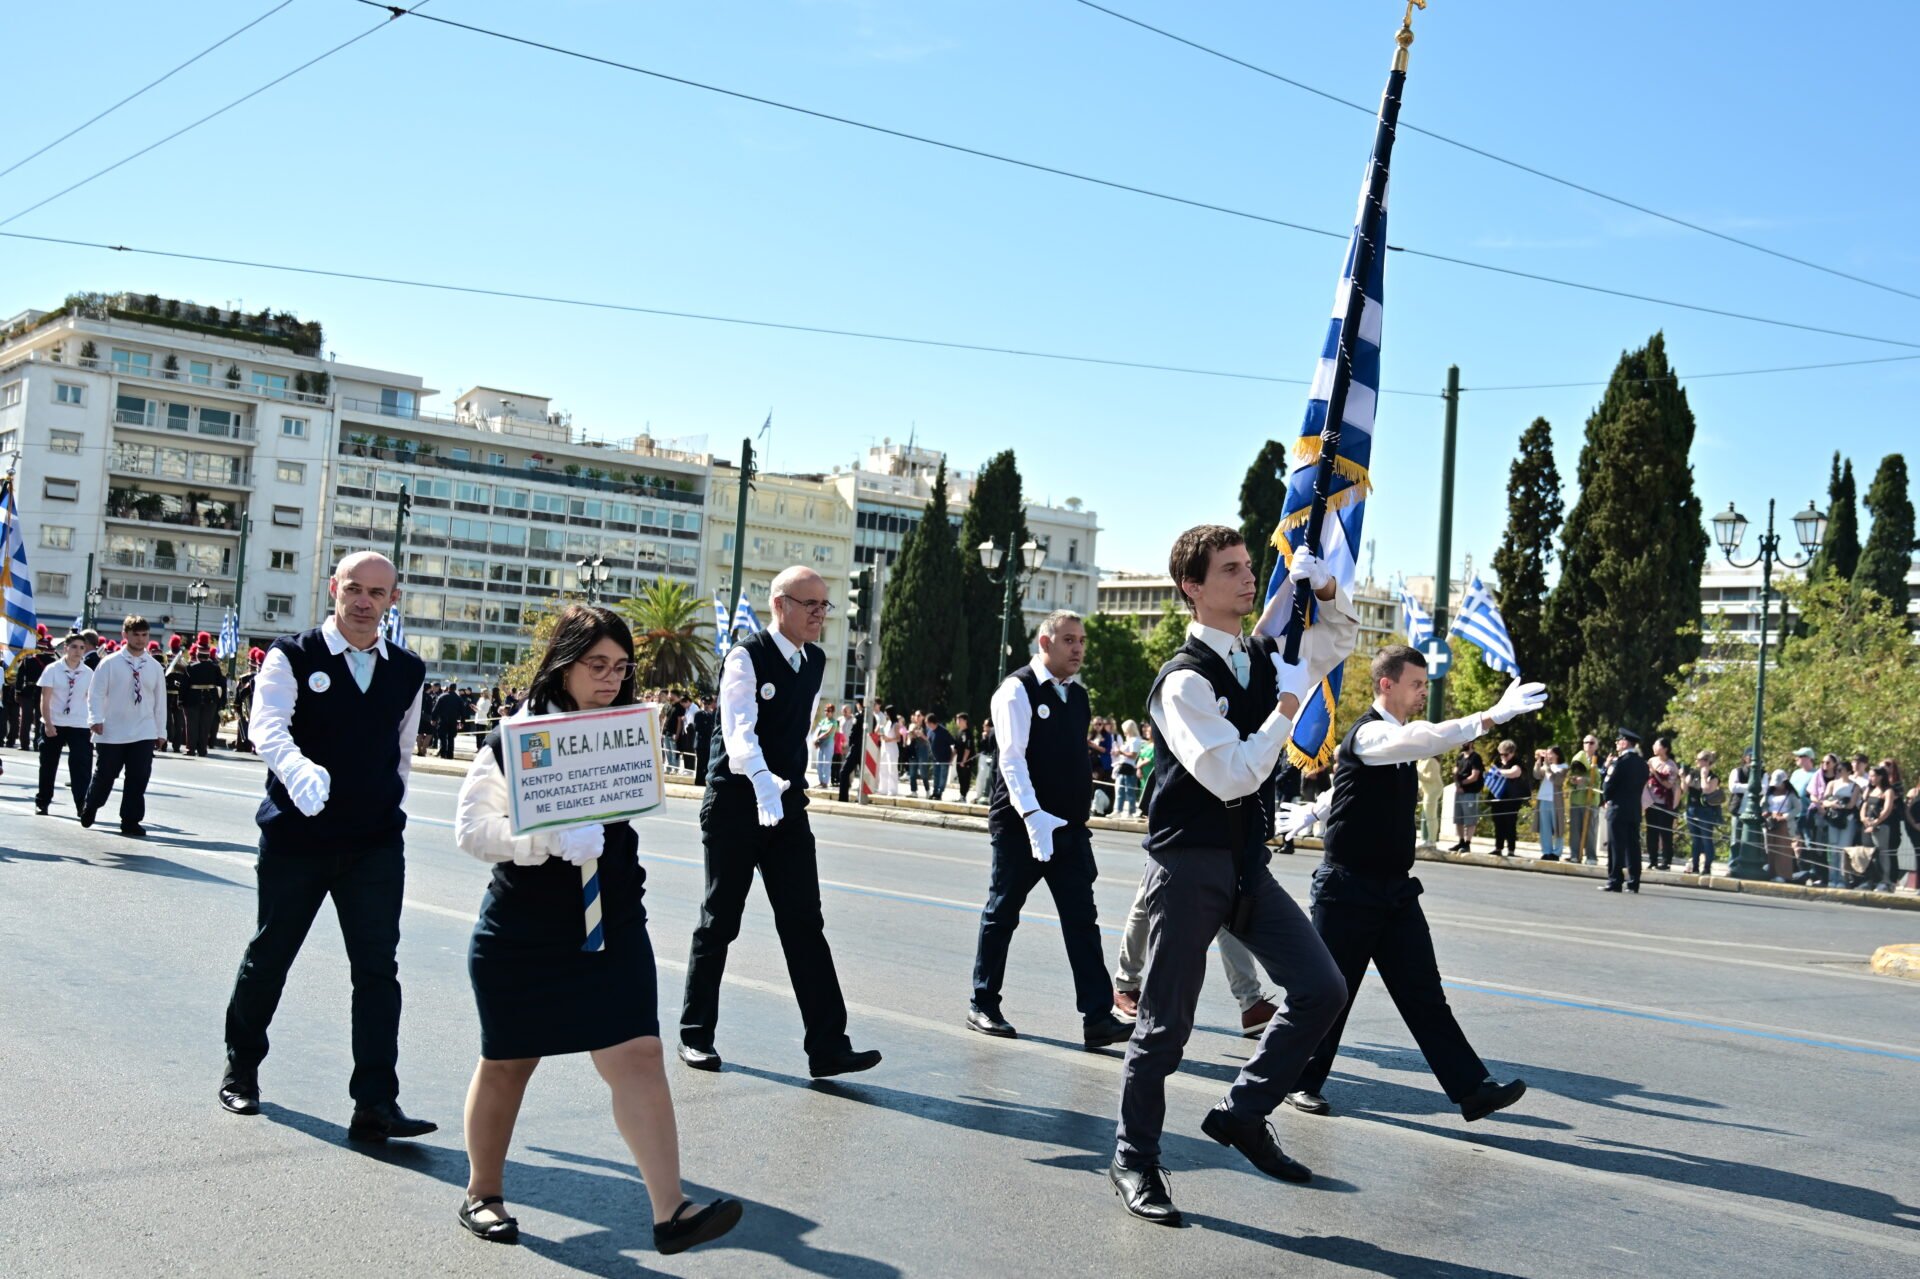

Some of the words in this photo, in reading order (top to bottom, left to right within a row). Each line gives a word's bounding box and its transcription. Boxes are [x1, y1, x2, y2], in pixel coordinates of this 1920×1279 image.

[521, 773, 563, 786] ΚΕΝΤΡΟ
[569, 760, 652, 778] ΕΠΑΓΓΕΛΜΑΤΙΚΗΣ
[524, 781, 607, 801] ΑΠΟΚΑΤΑΣΤΑΣΗΣ
[613, 773, 652, 787] ΑΤΟΜΩΝ
[536, 804, 551, 813] ΜΕ
[557, 796, 594, 810] ΕΙΔΙΚΕΣ
[600, 788, 644, 803] ΑΝΑΓΚΕΣ
